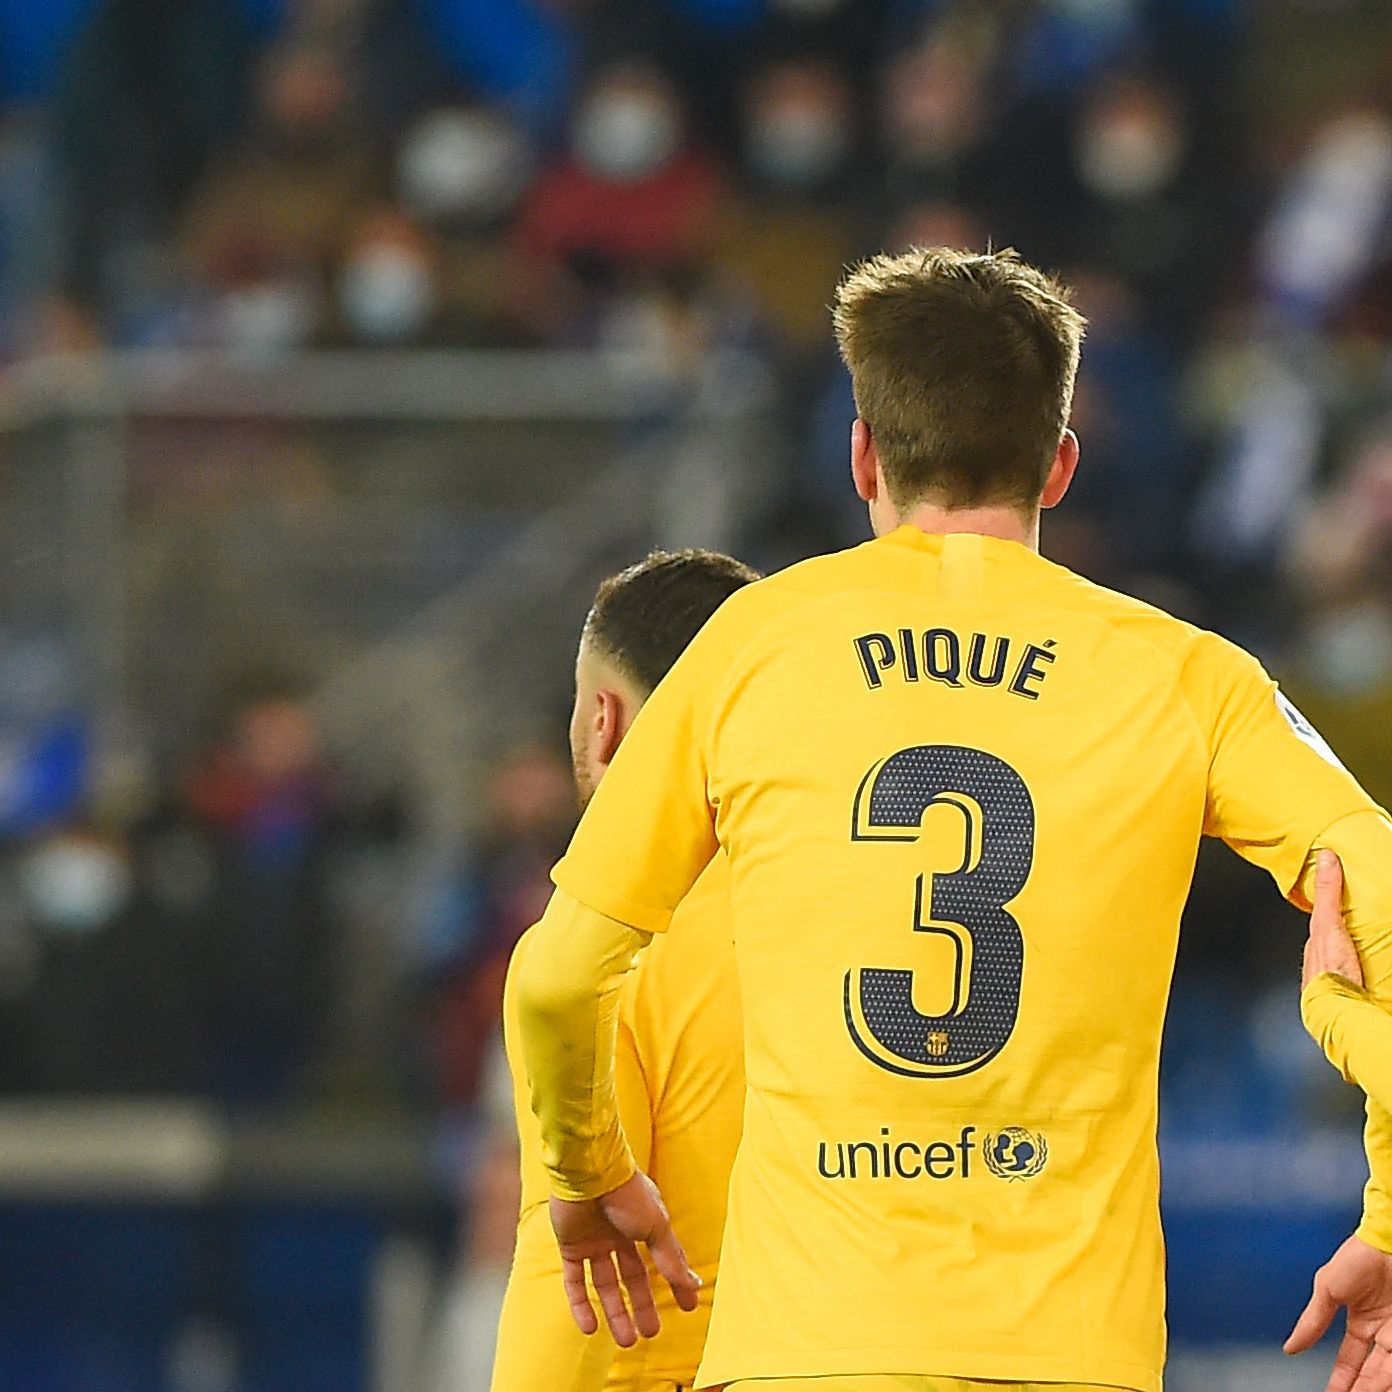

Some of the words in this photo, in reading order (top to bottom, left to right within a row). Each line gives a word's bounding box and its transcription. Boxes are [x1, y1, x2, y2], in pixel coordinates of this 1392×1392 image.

[854, 628, 1057, 699] PIQUÉ
[843, 745, 1035, 1078] 3
[817, 1127, 976, 1179] unicef
